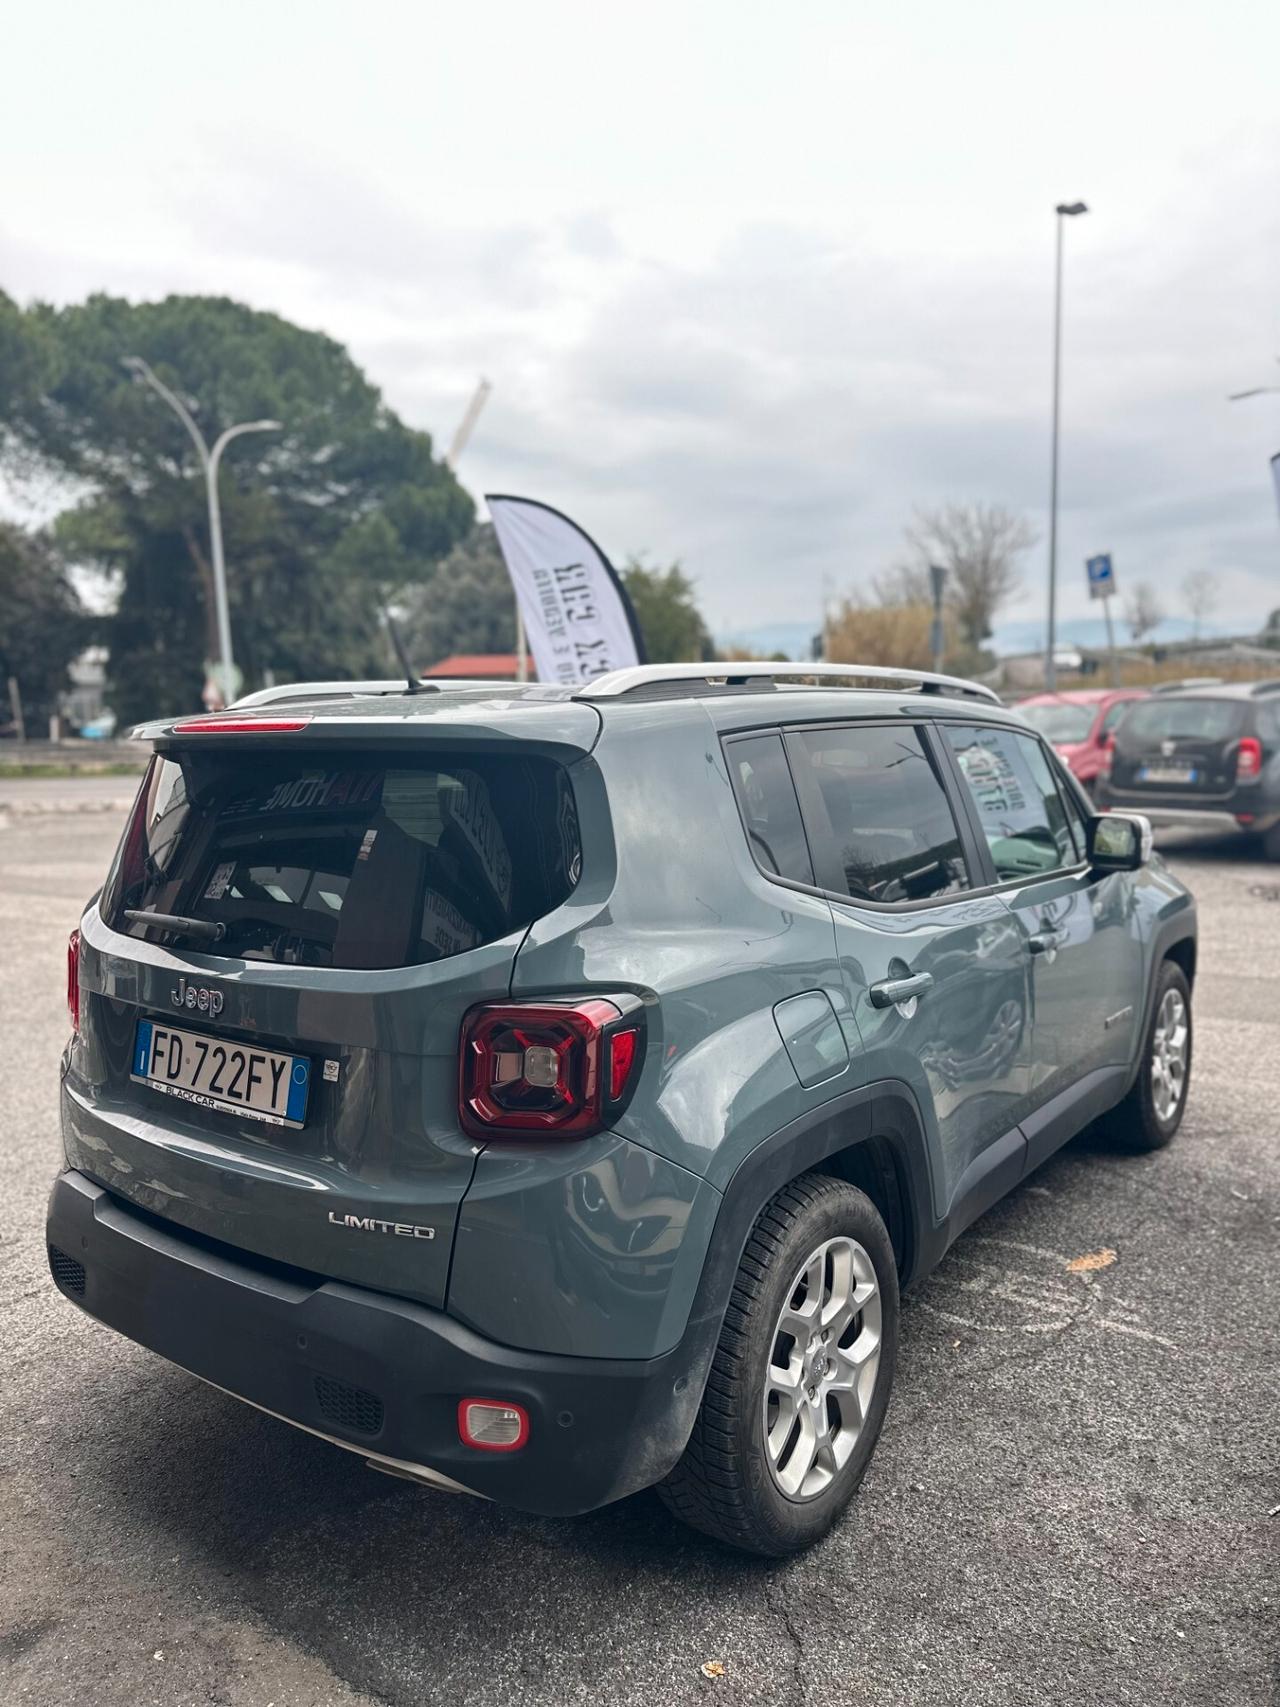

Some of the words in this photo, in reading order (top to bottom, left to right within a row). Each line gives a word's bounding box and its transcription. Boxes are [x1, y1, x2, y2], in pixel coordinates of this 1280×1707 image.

[170, 977, 224, 1018] Jeep
[166, 1086, 195, 1102] BLACK
[195, 1095, 215, 1109] CAR
[328, 1211, 435, 1239] LIMITED
